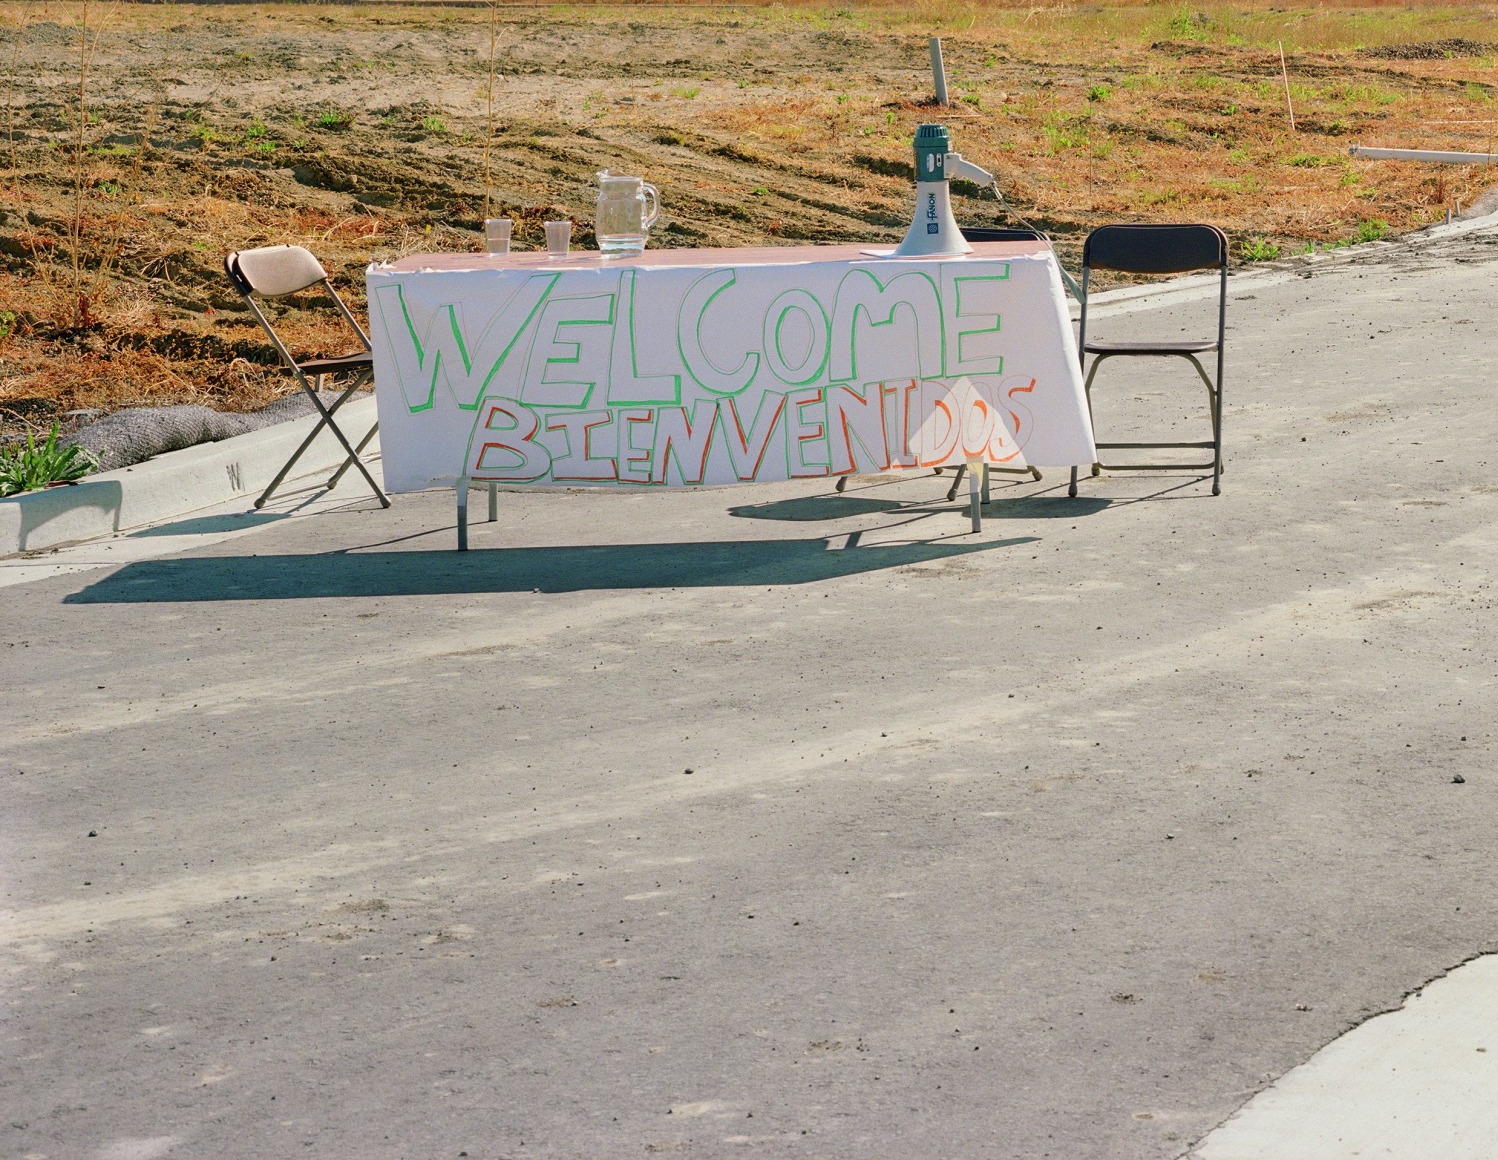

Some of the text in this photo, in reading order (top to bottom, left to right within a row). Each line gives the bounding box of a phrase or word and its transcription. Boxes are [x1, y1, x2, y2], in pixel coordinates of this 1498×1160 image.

[927, 193, 938, 221] FANON
[375, 262, 1011, 416] WELCOME
[462, 375, 1037, 486] BIENVENIDOS
